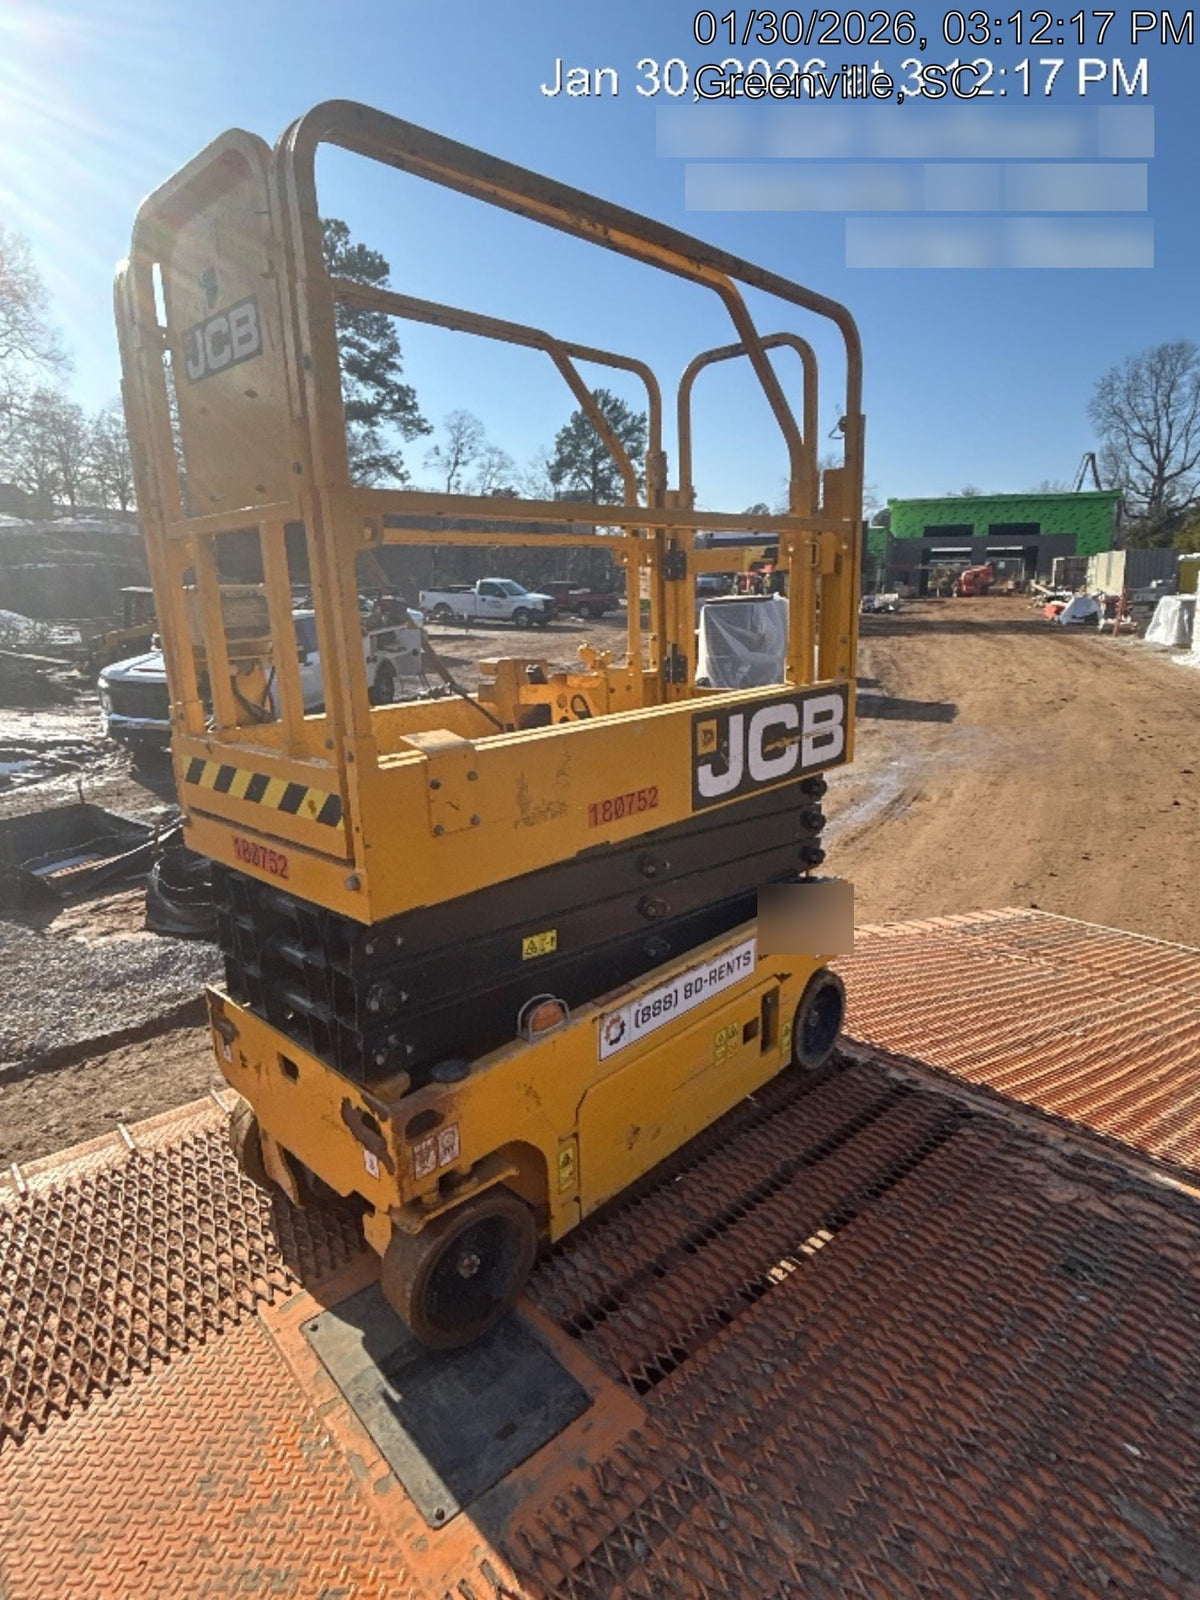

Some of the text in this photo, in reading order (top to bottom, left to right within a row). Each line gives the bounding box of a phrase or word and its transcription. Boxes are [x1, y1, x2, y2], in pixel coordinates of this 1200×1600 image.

[187, 303, 259, 379] JCB
[697, 694, 844, 797] JCB
[589, 786, 659, 827] 180752
[234, 838, 288, 879] 180752
[634, 988, 679, 1028] (888)
